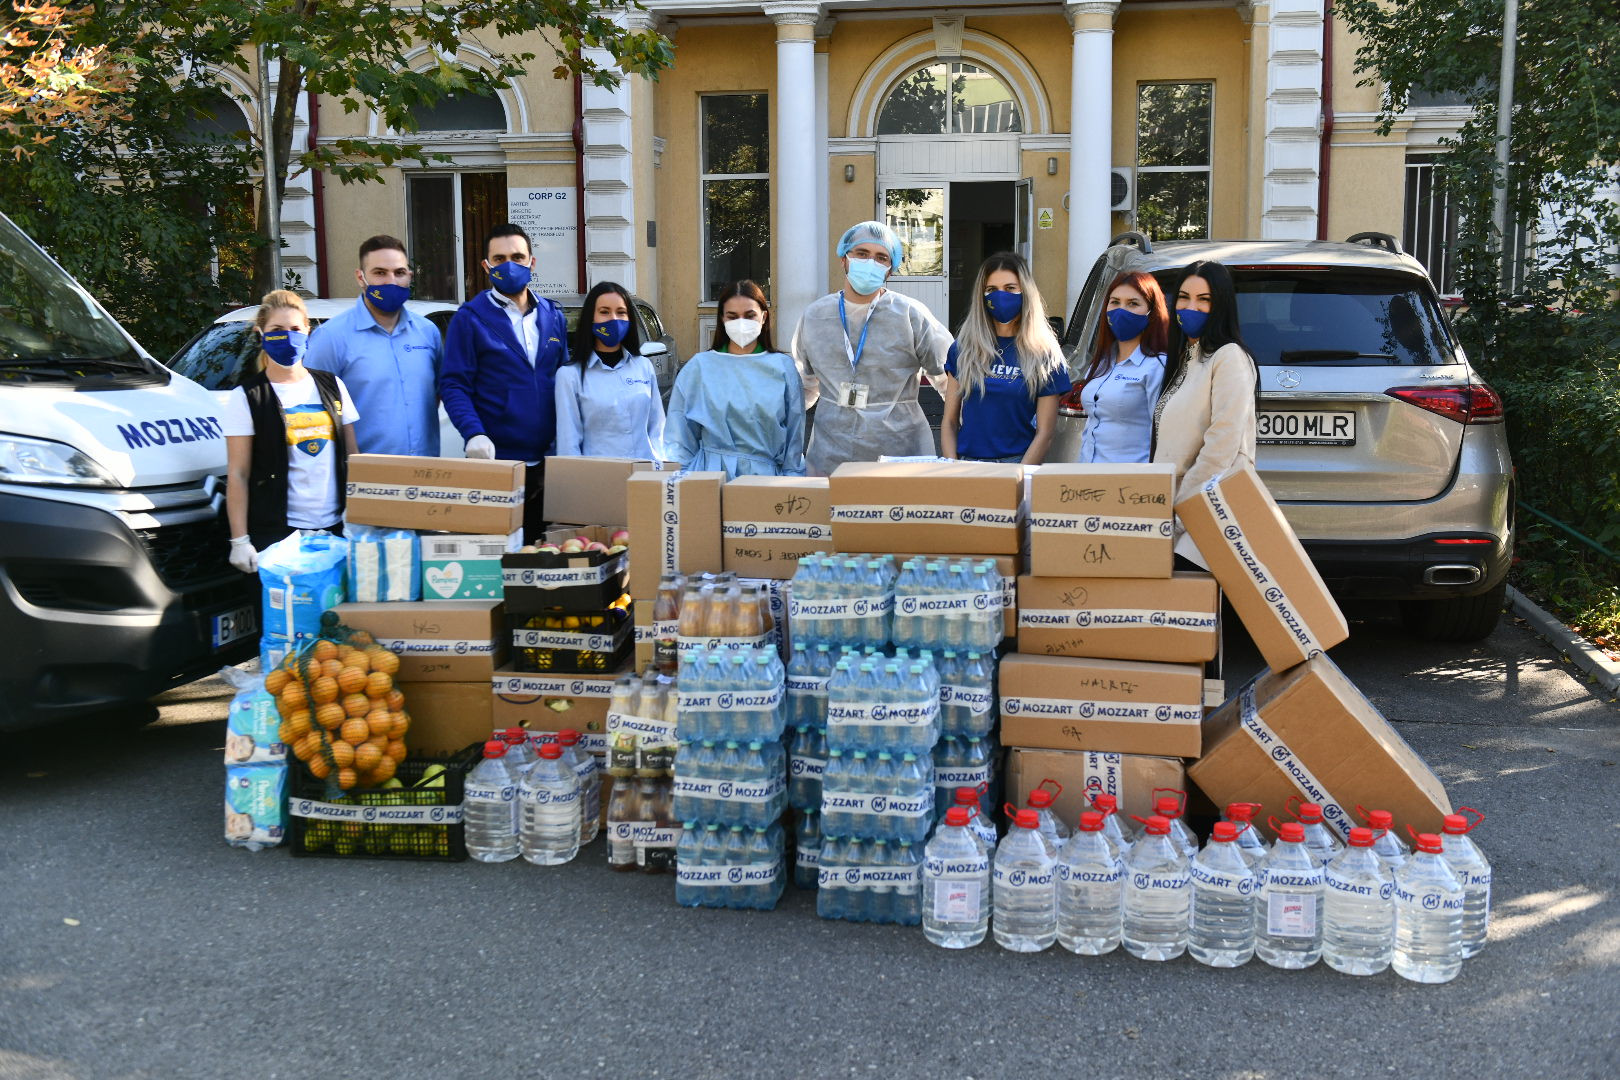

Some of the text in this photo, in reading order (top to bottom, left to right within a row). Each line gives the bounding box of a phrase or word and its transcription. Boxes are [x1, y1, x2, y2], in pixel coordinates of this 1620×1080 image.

[528, 192, 567, 200] CORP G2
[1259, 414, 1348, 436] 300 MLR
[116, 416, 224, 450] MOZZART
[358, 487, 400, 496] MOZZART
[420, 490, 464, 500] MOZZART
[837, 510, 884, 519] MOZZART
[906, 510, 954, 519] MOZZART
[1031, 518, 1078, 528] MOZZART
[1102, 522, 1153, 532] MOZZART
[666, 526, 674, 570] MOZZART
[1205, 485, 1228, 521] OZZART
[1234, 542, 1268, 584] MOZZART
[1276, 603, 1311, 646] MOZZART
[537, 573, 579, 581] MOZZART
[801, 605, 848, 614] MOZZART
[920, 600, 968, 609] MOZZART
[1022, 615, 1070, 624] MOZZART
[1094, 615, 1144, 623] MOZZART
[1168, 617, 1217, 627] MOZZART
[540, 636, 584, 646] MOZZART
[523, 682, 566, 691] MOZZART
[586, 685, 612, 693] MOZZ
[686, 697, 711, 706] ZART
[828, 708, 864, 718] OZZART
[1022, 704, 1073, 714] MOZZART
[1097, 708, 1149, 718] MOZZART
[622, 720, 668, 734] MOZZART
[939, 772, 986, 782] MOZZART
[1106, 766, 1116, 795] MOZZ
[1284, 761, 1325, 801] MOZZART
[682, 784, 712, 793] ZZART
[832, 798, 864, 808] ZZART
[314, 806, 357, 818] MOZZART
[379, 810, 424, 819] MOZZART
[677, 869, 721, 880] MOZZART
[863, 872, 912, 881] MOZZART
[1072, 872, 1122, 882] MOZZAR
[1270, 875, 1322, 886] MOZZART
